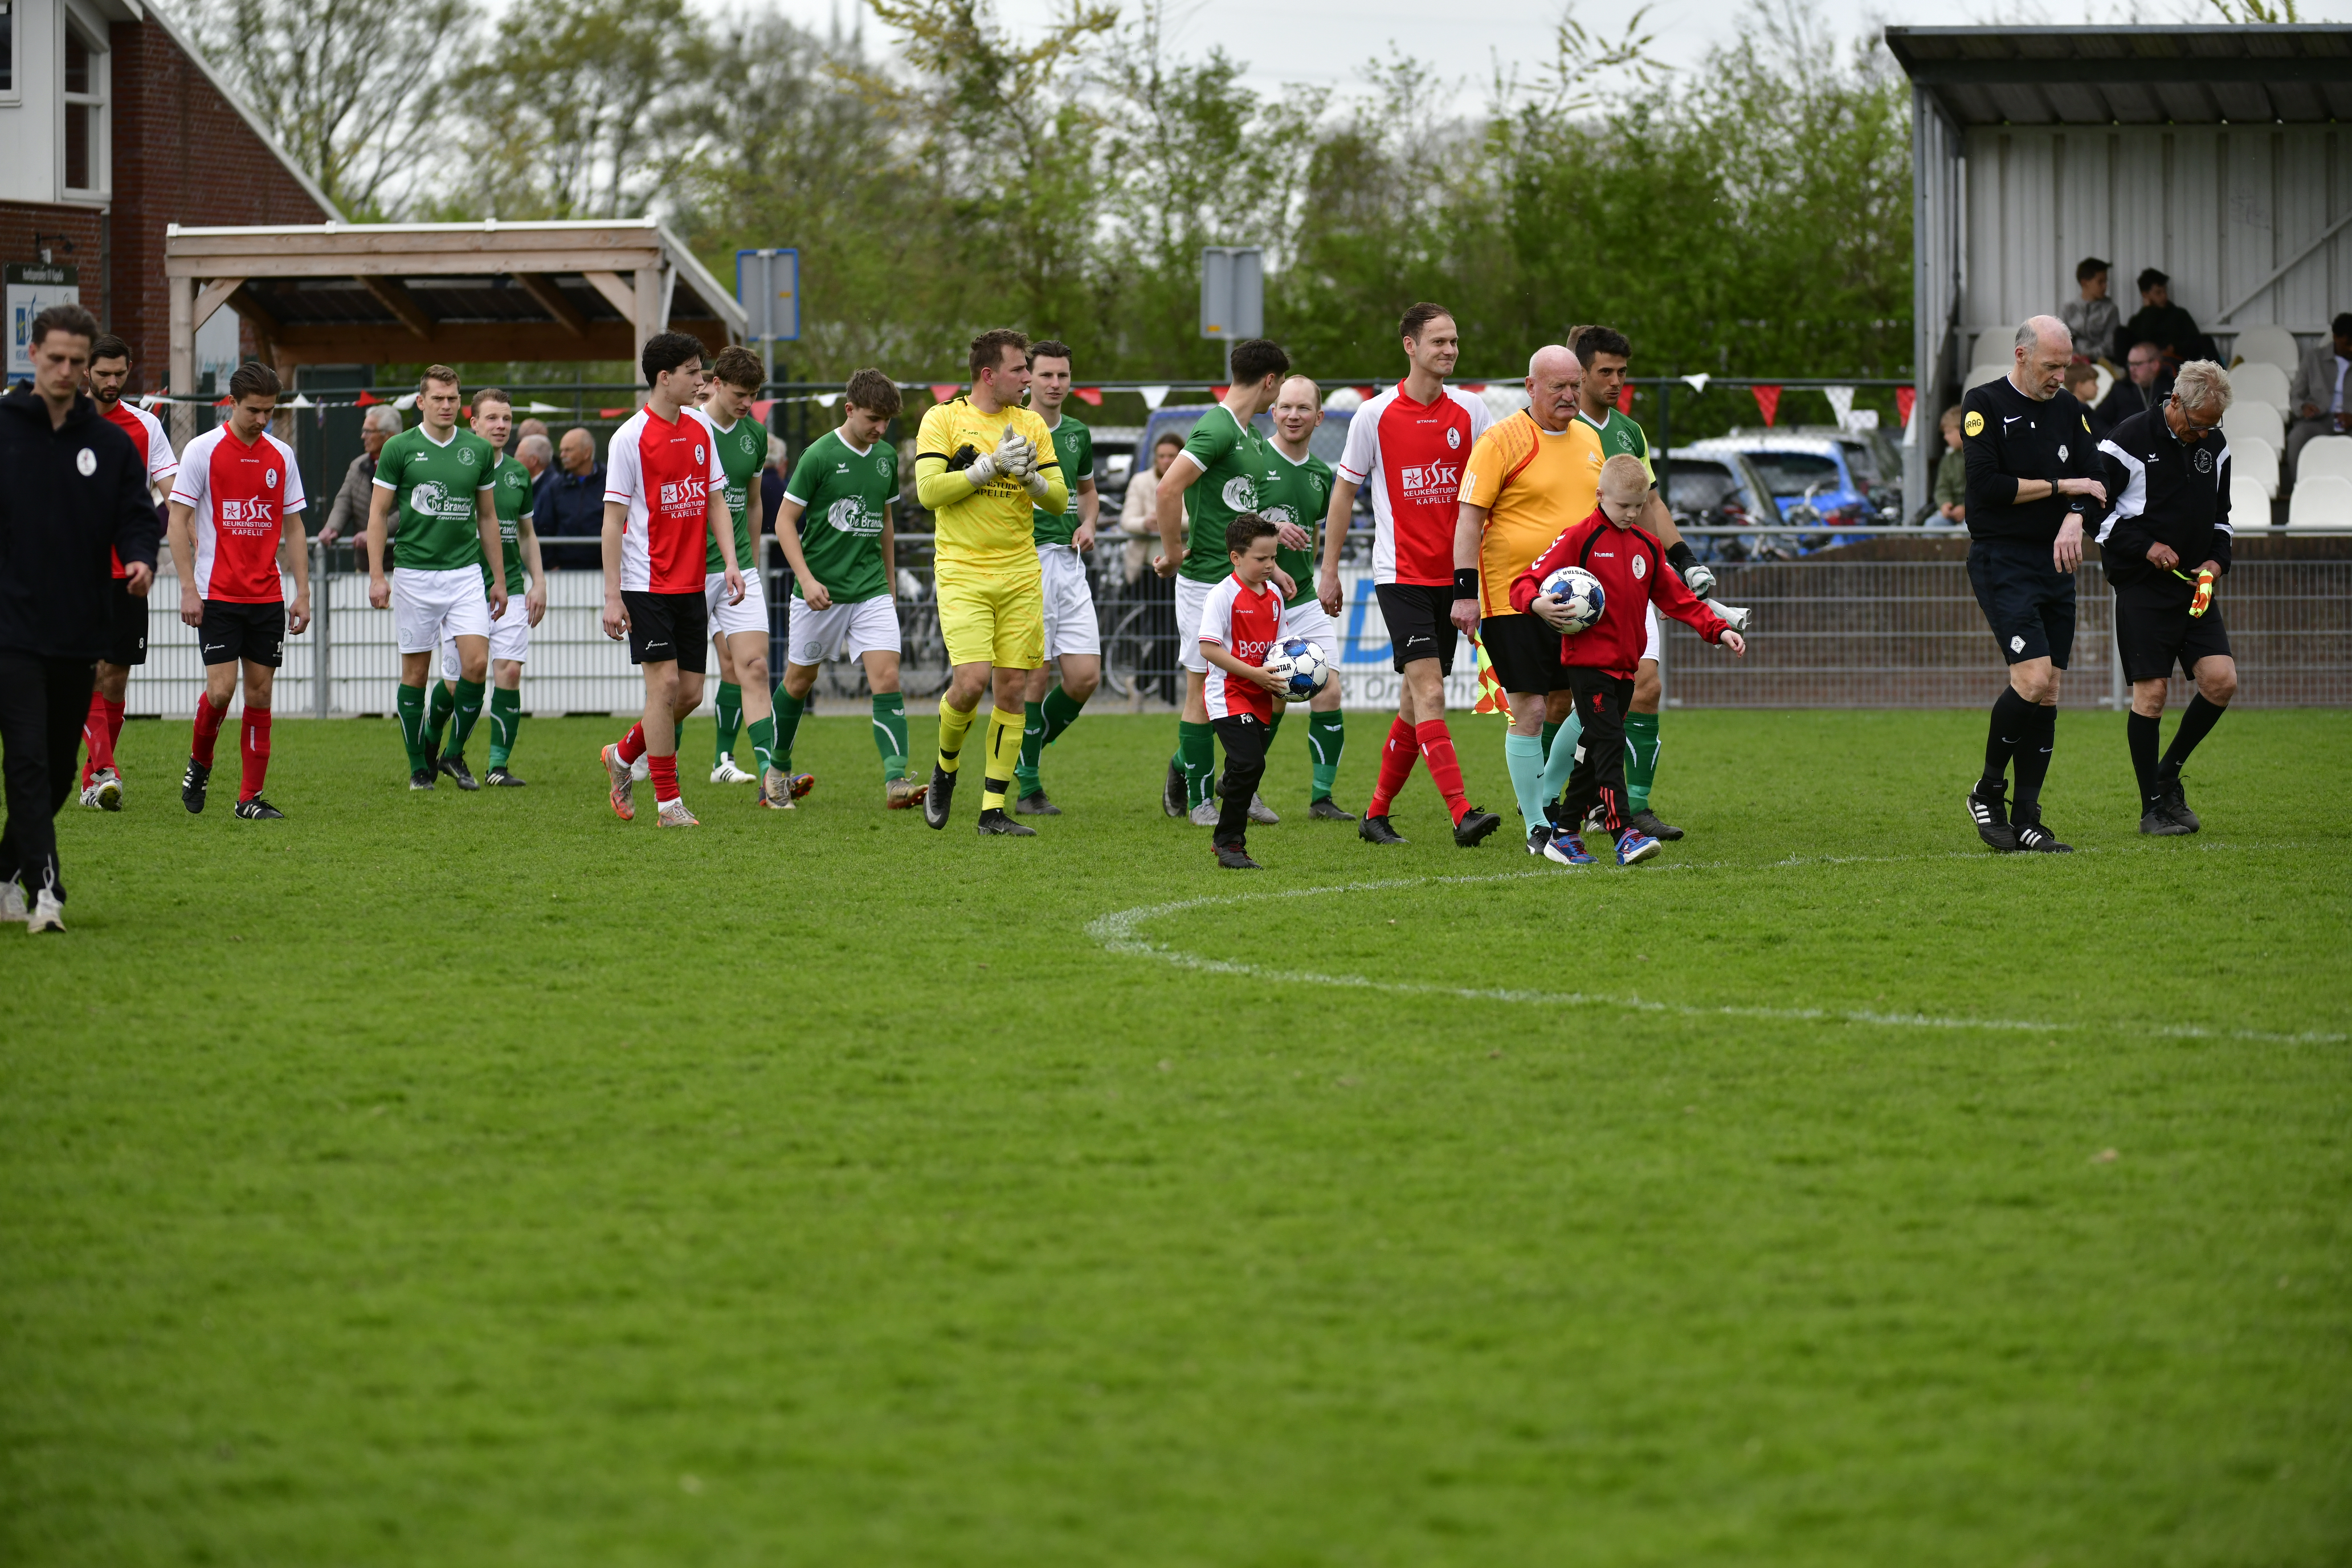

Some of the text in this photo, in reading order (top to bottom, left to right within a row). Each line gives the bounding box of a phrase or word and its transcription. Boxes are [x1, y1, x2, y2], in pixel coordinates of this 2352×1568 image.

[1966, 419, 1981, 430] ARAG
[1424, 458, 1457, 489] SSK
[679, 473, 706, 503] SSK
[985, 480, 1022, 491] NSTUDIO
[974, 489, 1011, 498] APELLE
[1403, 487, 1457, 497] KEUKENSTUDIO
[1416, 496, 1451, 505] KAPELLE
[242, 495, 272, 522] SSK
[671, 509, 701, 518] KAPELLE
[1562, 570, 1597, 582] DERBYSTAR
[138, 637, 144, 649] 8
